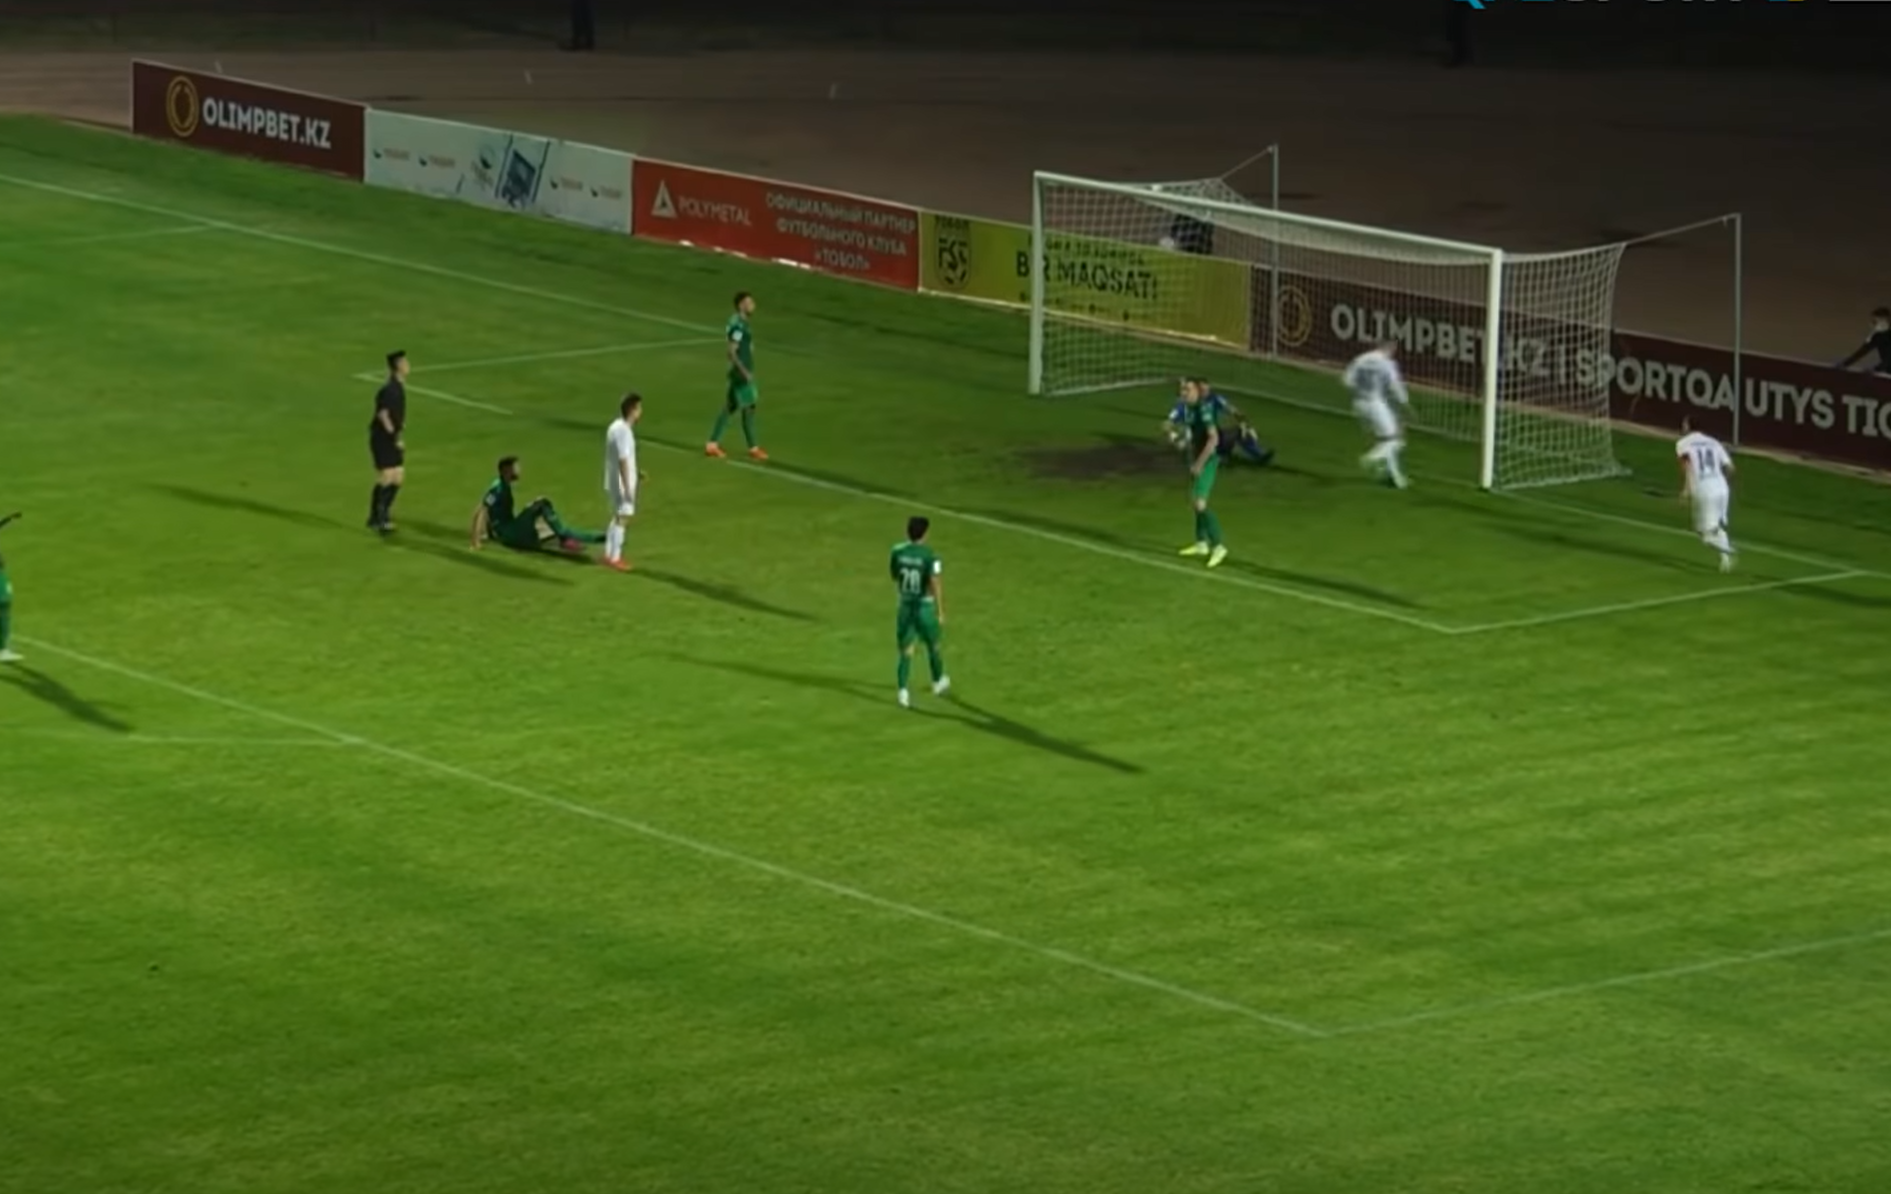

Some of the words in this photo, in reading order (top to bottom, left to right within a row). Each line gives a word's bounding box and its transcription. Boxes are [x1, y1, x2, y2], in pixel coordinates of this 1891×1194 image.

[202, 96, 332, 149] OLIMPBET.KZ
[678, 195, 752, 226] POLYMETAL
[867, 233, 908, 257] КЛУБА
[1017, 251, 1050, 282] BR
[1745, 378, 1836, 430] UTYS
